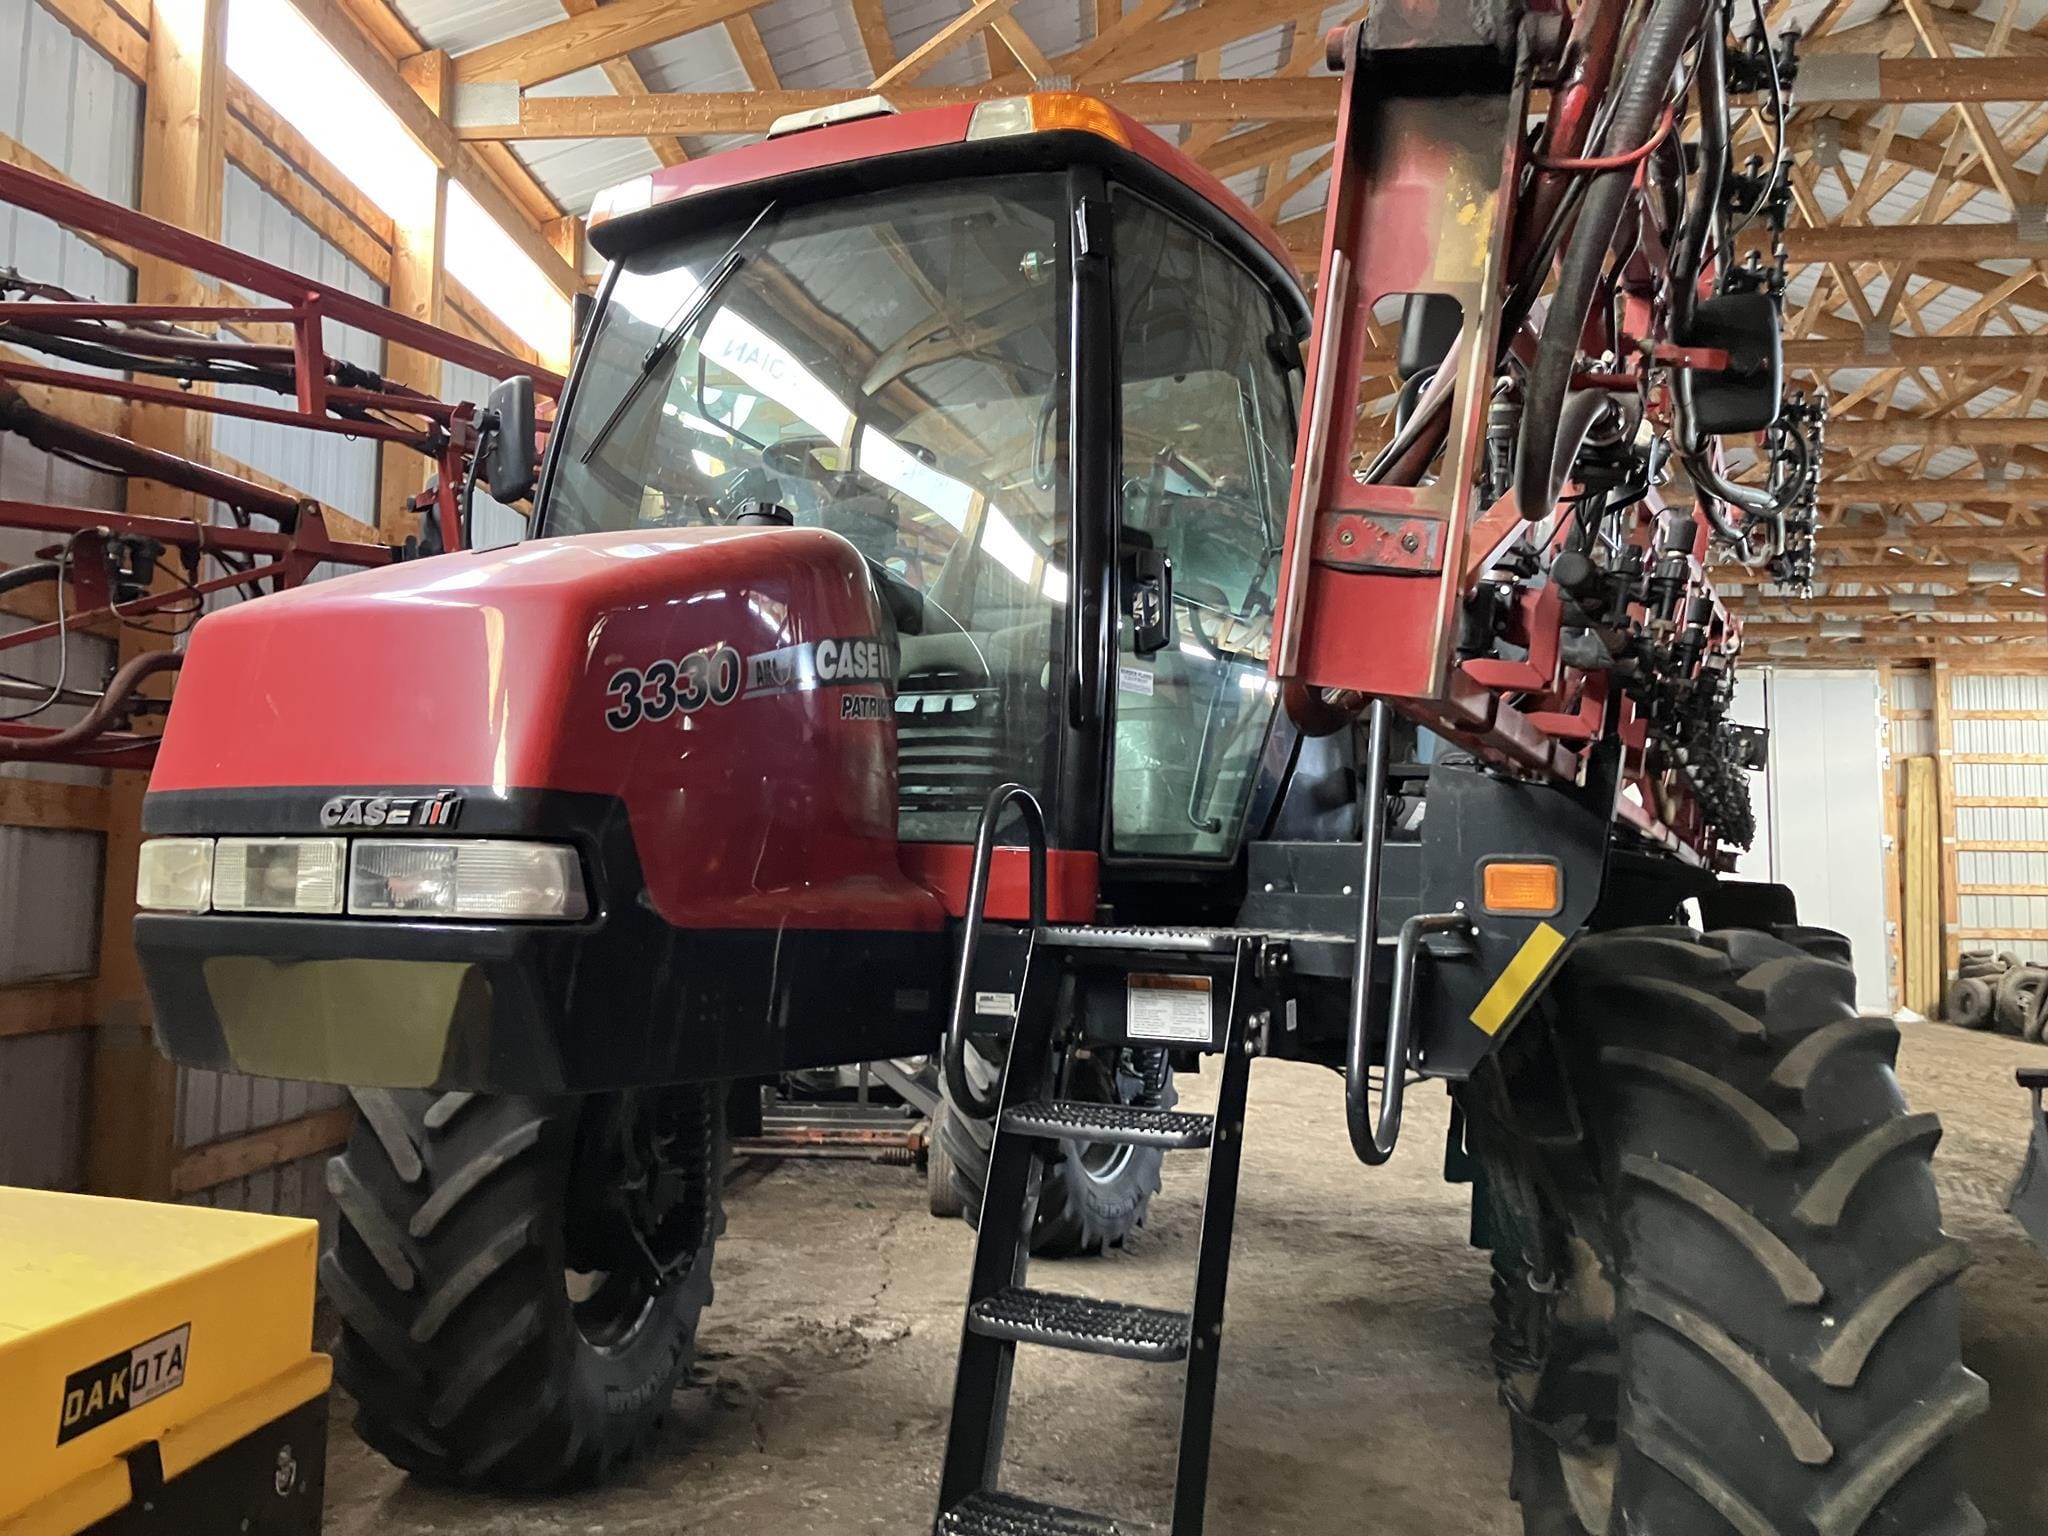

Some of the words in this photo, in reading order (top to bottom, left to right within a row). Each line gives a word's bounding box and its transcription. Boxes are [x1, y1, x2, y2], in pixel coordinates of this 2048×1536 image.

[604, 645, 742, 733] 3330
[815, 638, 879, 680] CASE
[319, 798, 418, 827] CASE
[62, 1342, 184, 1428] DAKOTA
